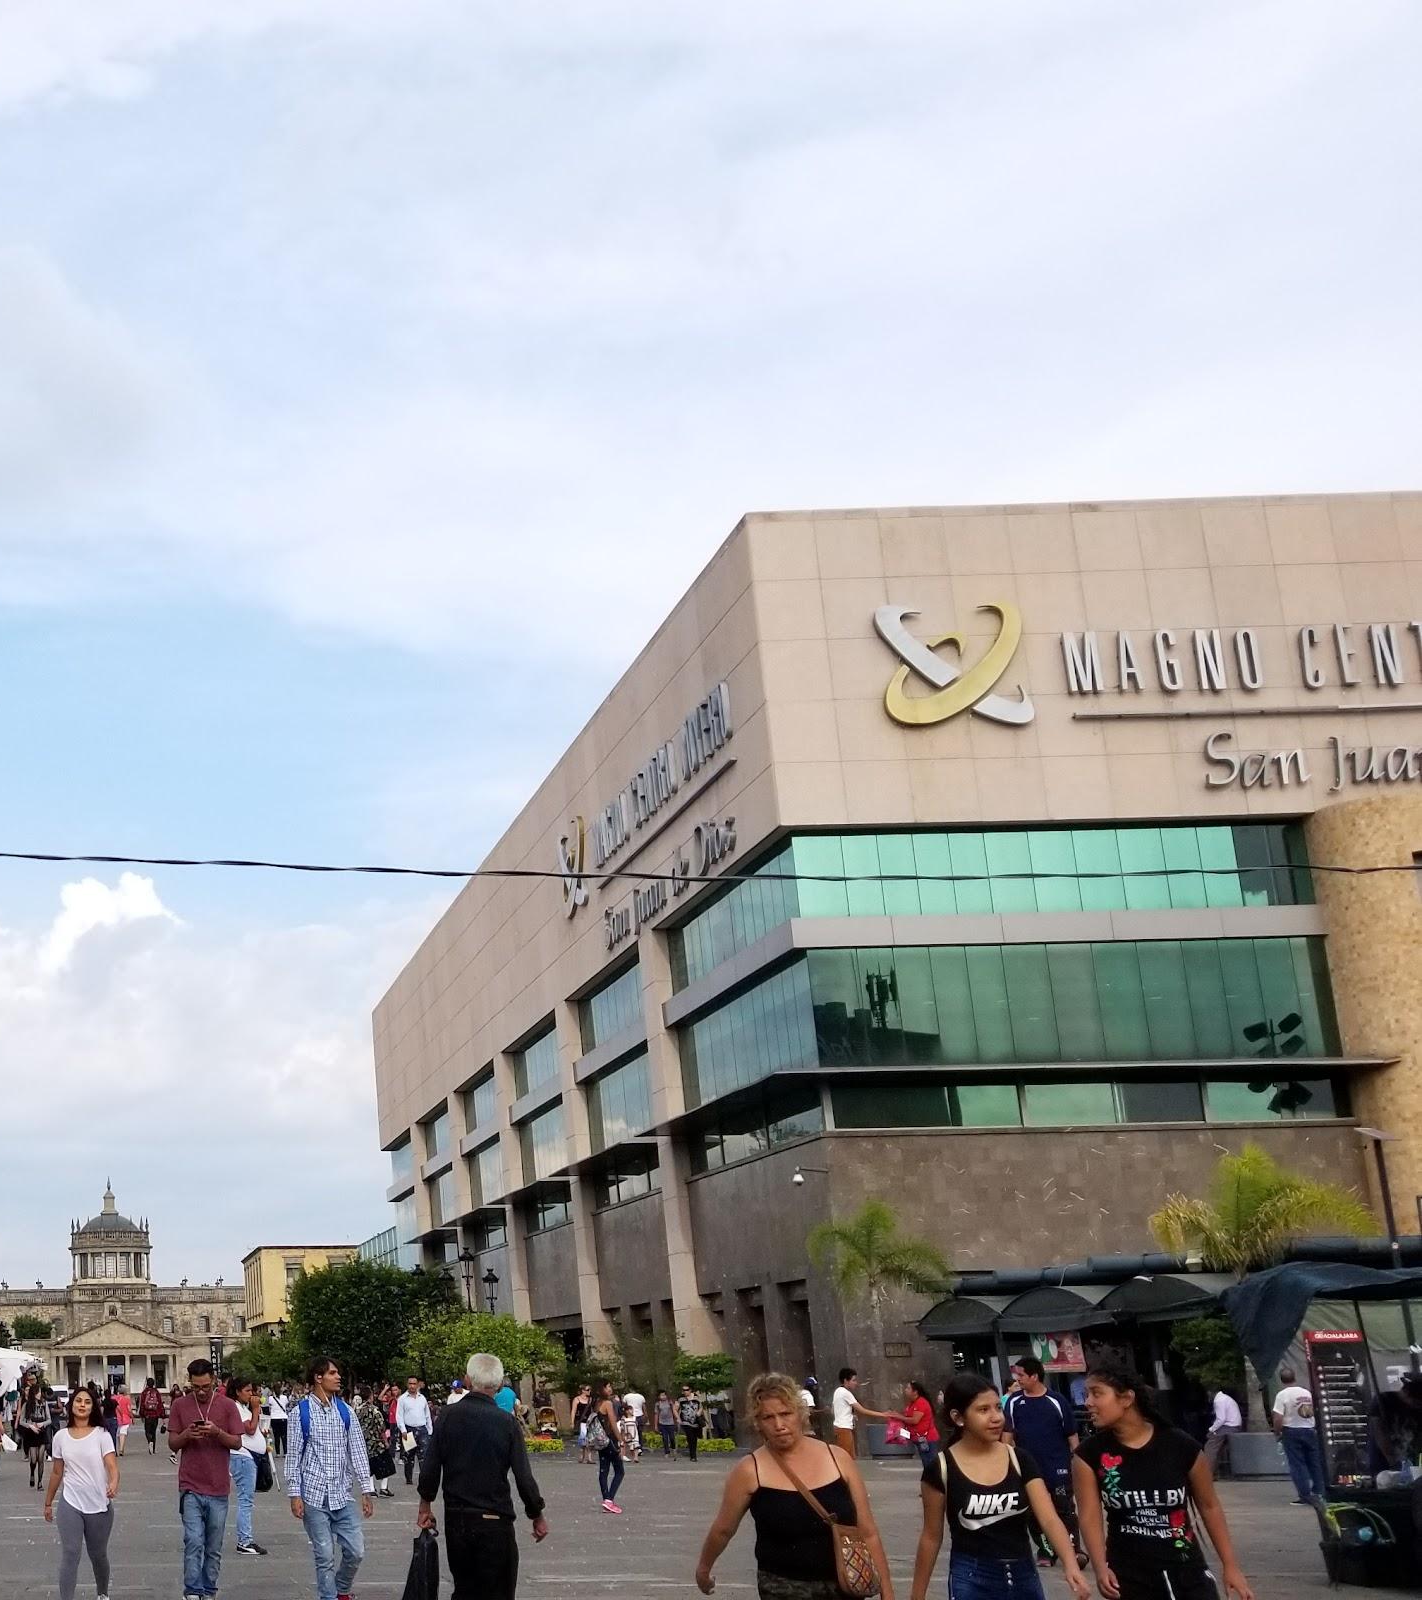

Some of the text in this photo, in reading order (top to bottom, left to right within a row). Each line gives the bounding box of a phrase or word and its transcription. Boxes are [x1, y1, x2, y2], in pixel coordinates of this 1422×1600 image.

[1059, 628, 1264, 696] MAGNO
[1203, 731, 1422, 793] San Jua
[964, 1491, 1020, 1516] NIKE
